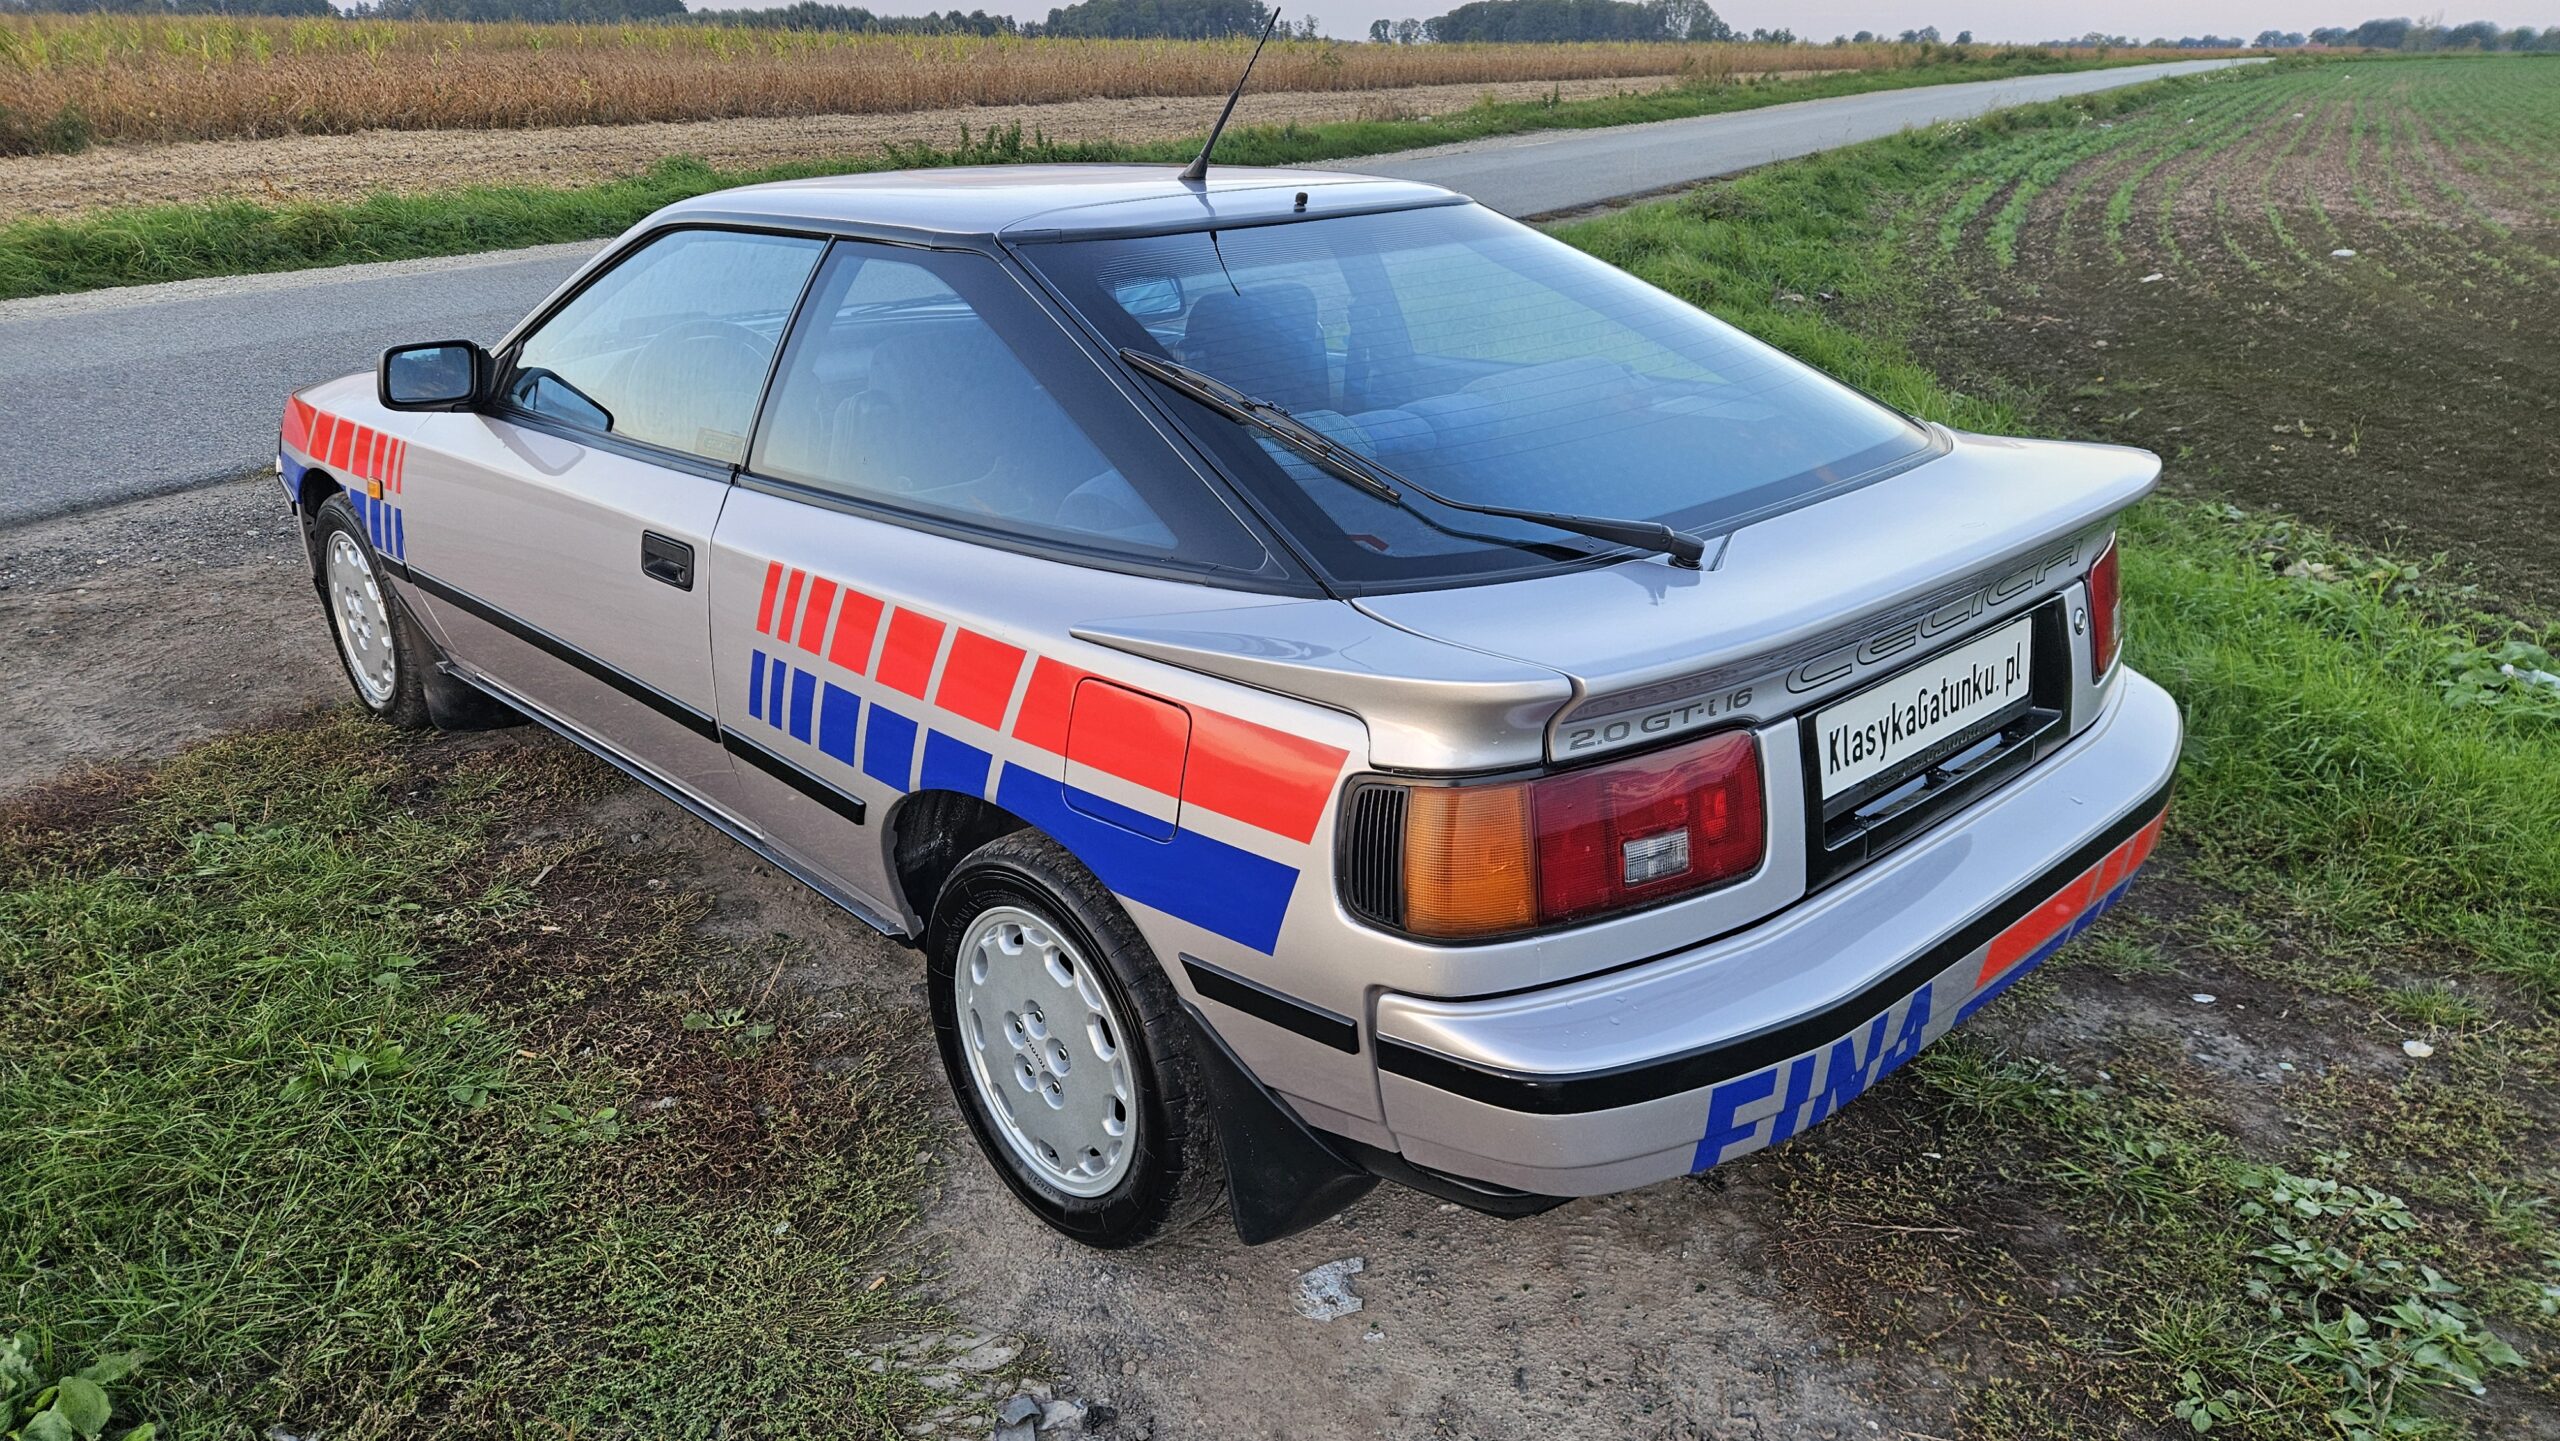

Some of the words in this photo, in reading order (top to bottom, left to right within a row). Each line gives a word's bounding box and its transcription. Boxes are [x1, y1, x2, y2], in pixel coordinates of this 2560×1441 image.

[1785, 537, 2084, 694] CELICA
[1569, 721, 1631, 751] 2.0
[1725, 687, 1753, 713] 16
[1025, 1035, 1046, 1071] TOYOTA
[1690, 981, 1933, 1175] FINA
